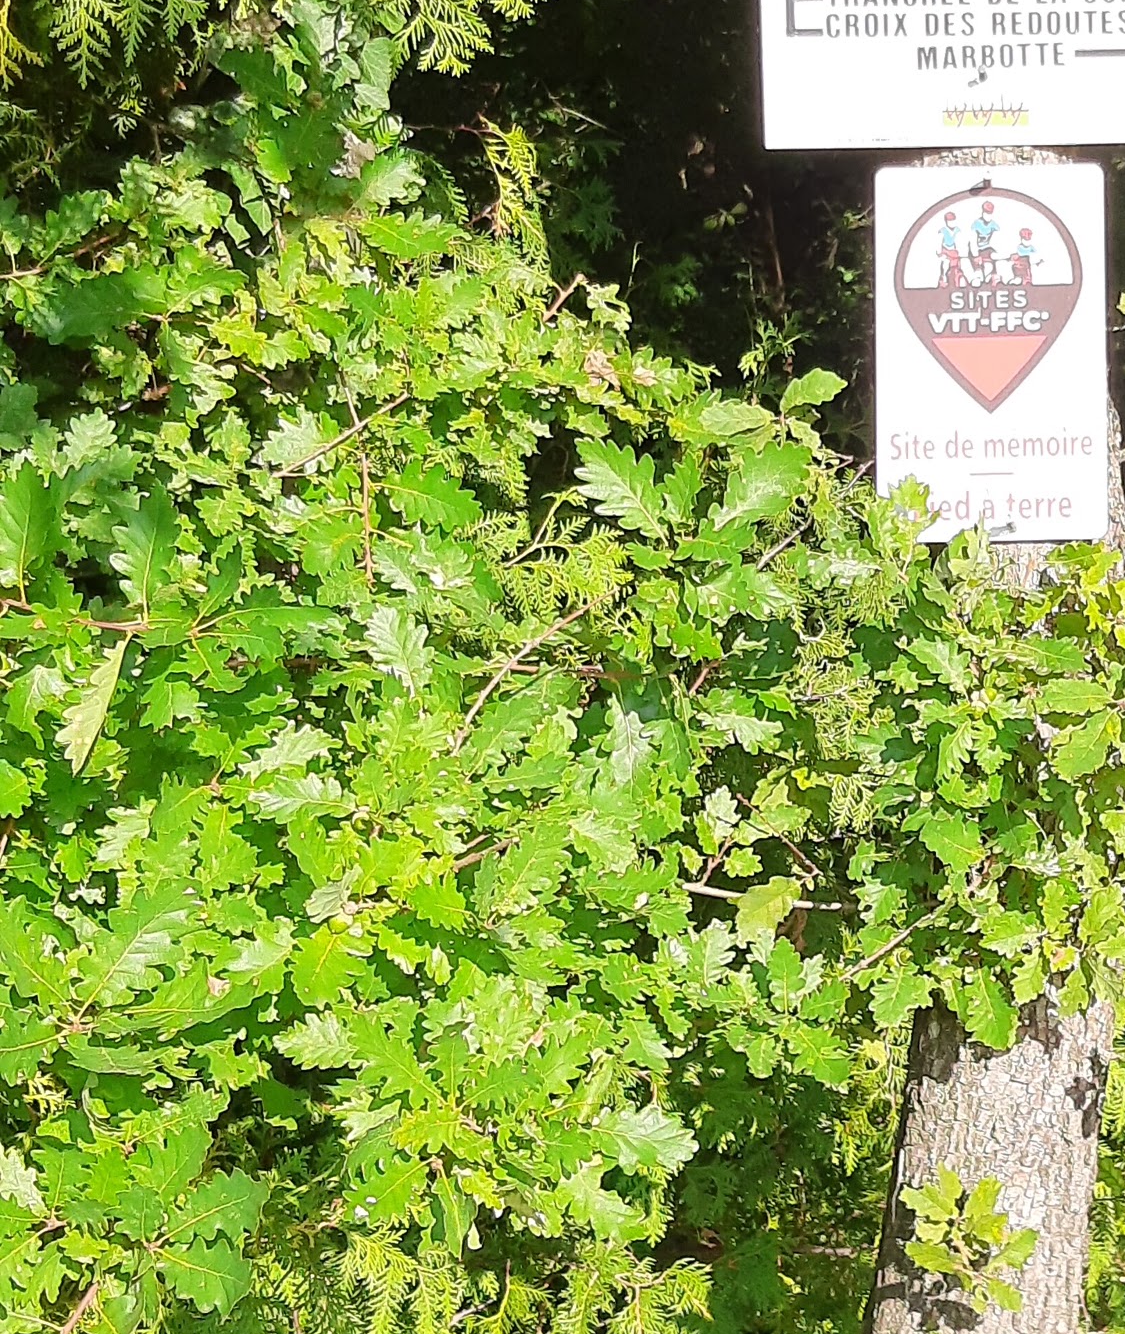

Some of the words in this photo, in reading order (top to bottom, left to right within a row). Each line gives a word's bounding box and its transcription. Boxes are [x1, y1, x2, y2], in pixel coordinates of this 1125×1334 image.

[825, 12, 908, 38] CROIX
[925, 12, 975, 37] DES
[917, 42, 1066, 71] MARBOTTE
[950, 289, 1028, 310] SITES
[890, 431, 935, 460] Site
[945, 429, 974, 459] de
[914, 490, 970, 522] ied
[983, 488, 995, 520] à
[1006, 492, 1073, 520] terre
